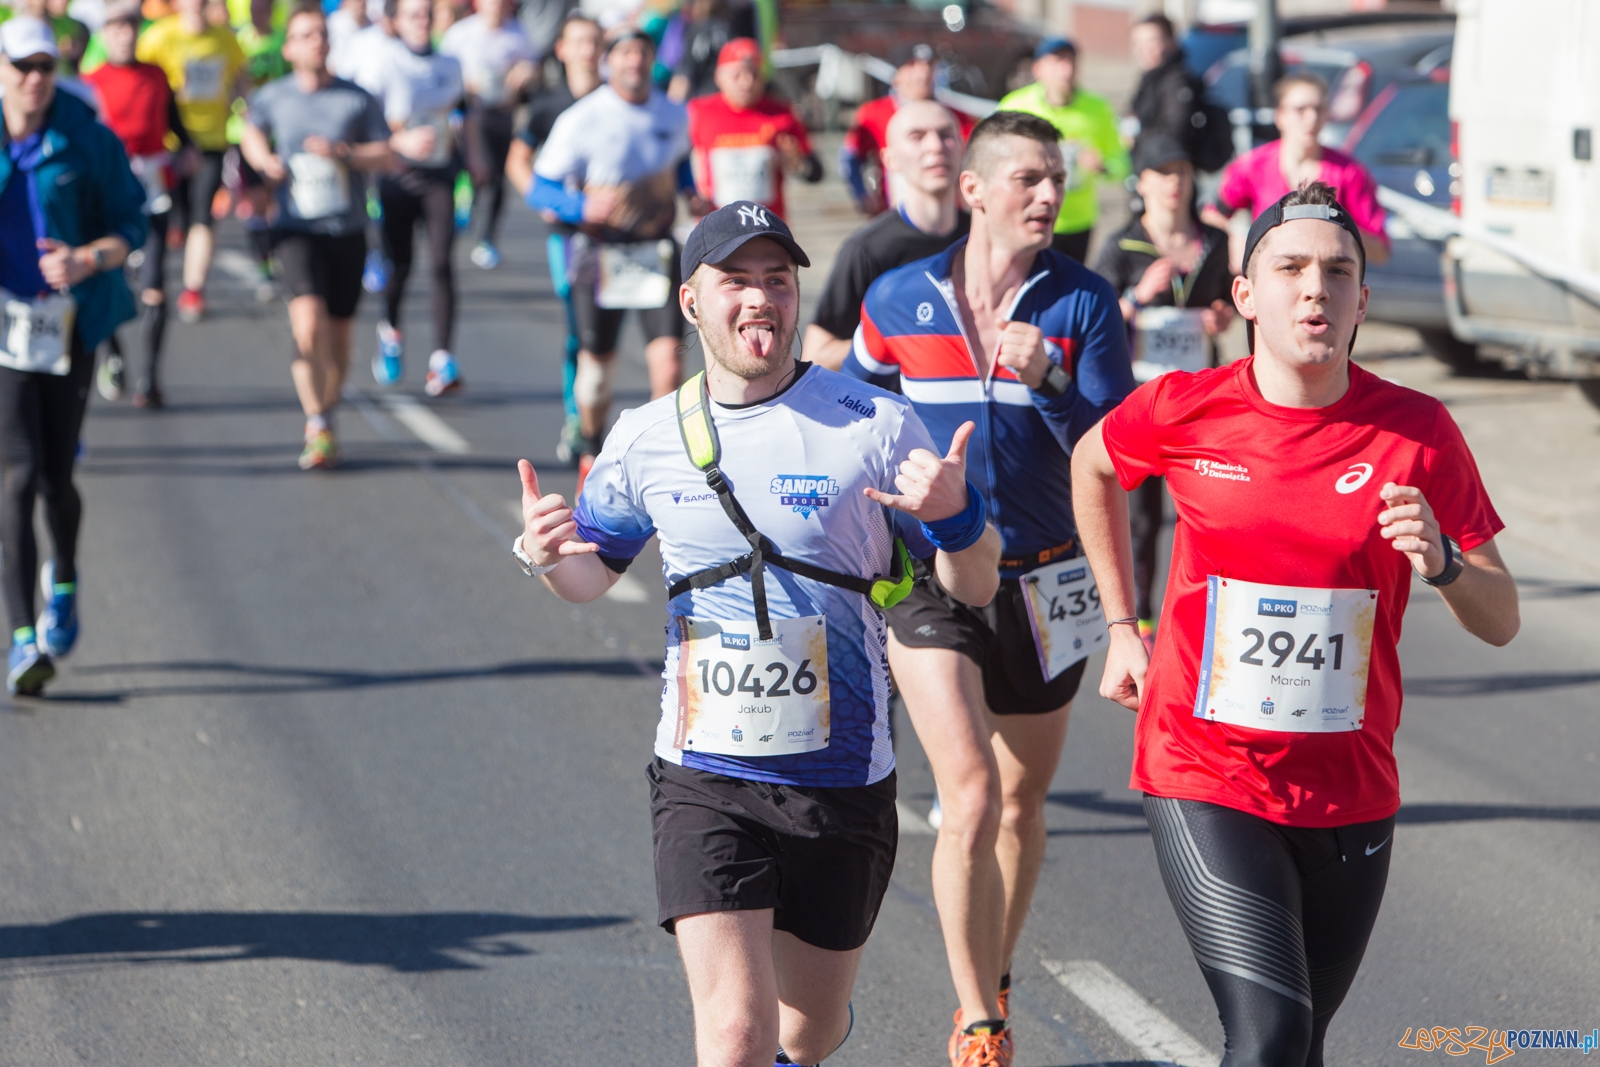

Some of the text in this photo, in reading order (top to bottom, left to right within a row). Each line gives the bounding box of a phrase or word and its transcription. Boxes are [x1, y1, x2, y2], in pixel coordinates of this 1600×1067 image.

[837, 394, 877, 420] Jakub
[1194, 459, 1249, 476] 13 Maniacka
[770, 477, 840, 495] SANPOL
[683, 492, 718, 504] SANPO
[783, 497, 826, 505] SPORT
[1048, 585, 1101, 622] 439
[1262, 602, 1274, 612] 10.
[1274, 604, 1294, 613] PKO
[723, 636, 733, 645] 10.
[732, 637, 748, 647] PKO
[1239, 627, 1345, 671] 2941
[697, 658, 818, 698] 10426
[1270, 674, 1311, 687] Marcin
[737, 704, 772, 714] Jakub
[1291, 709, 1308, 717] 4F
[759, 734, 774, 743] 4F
